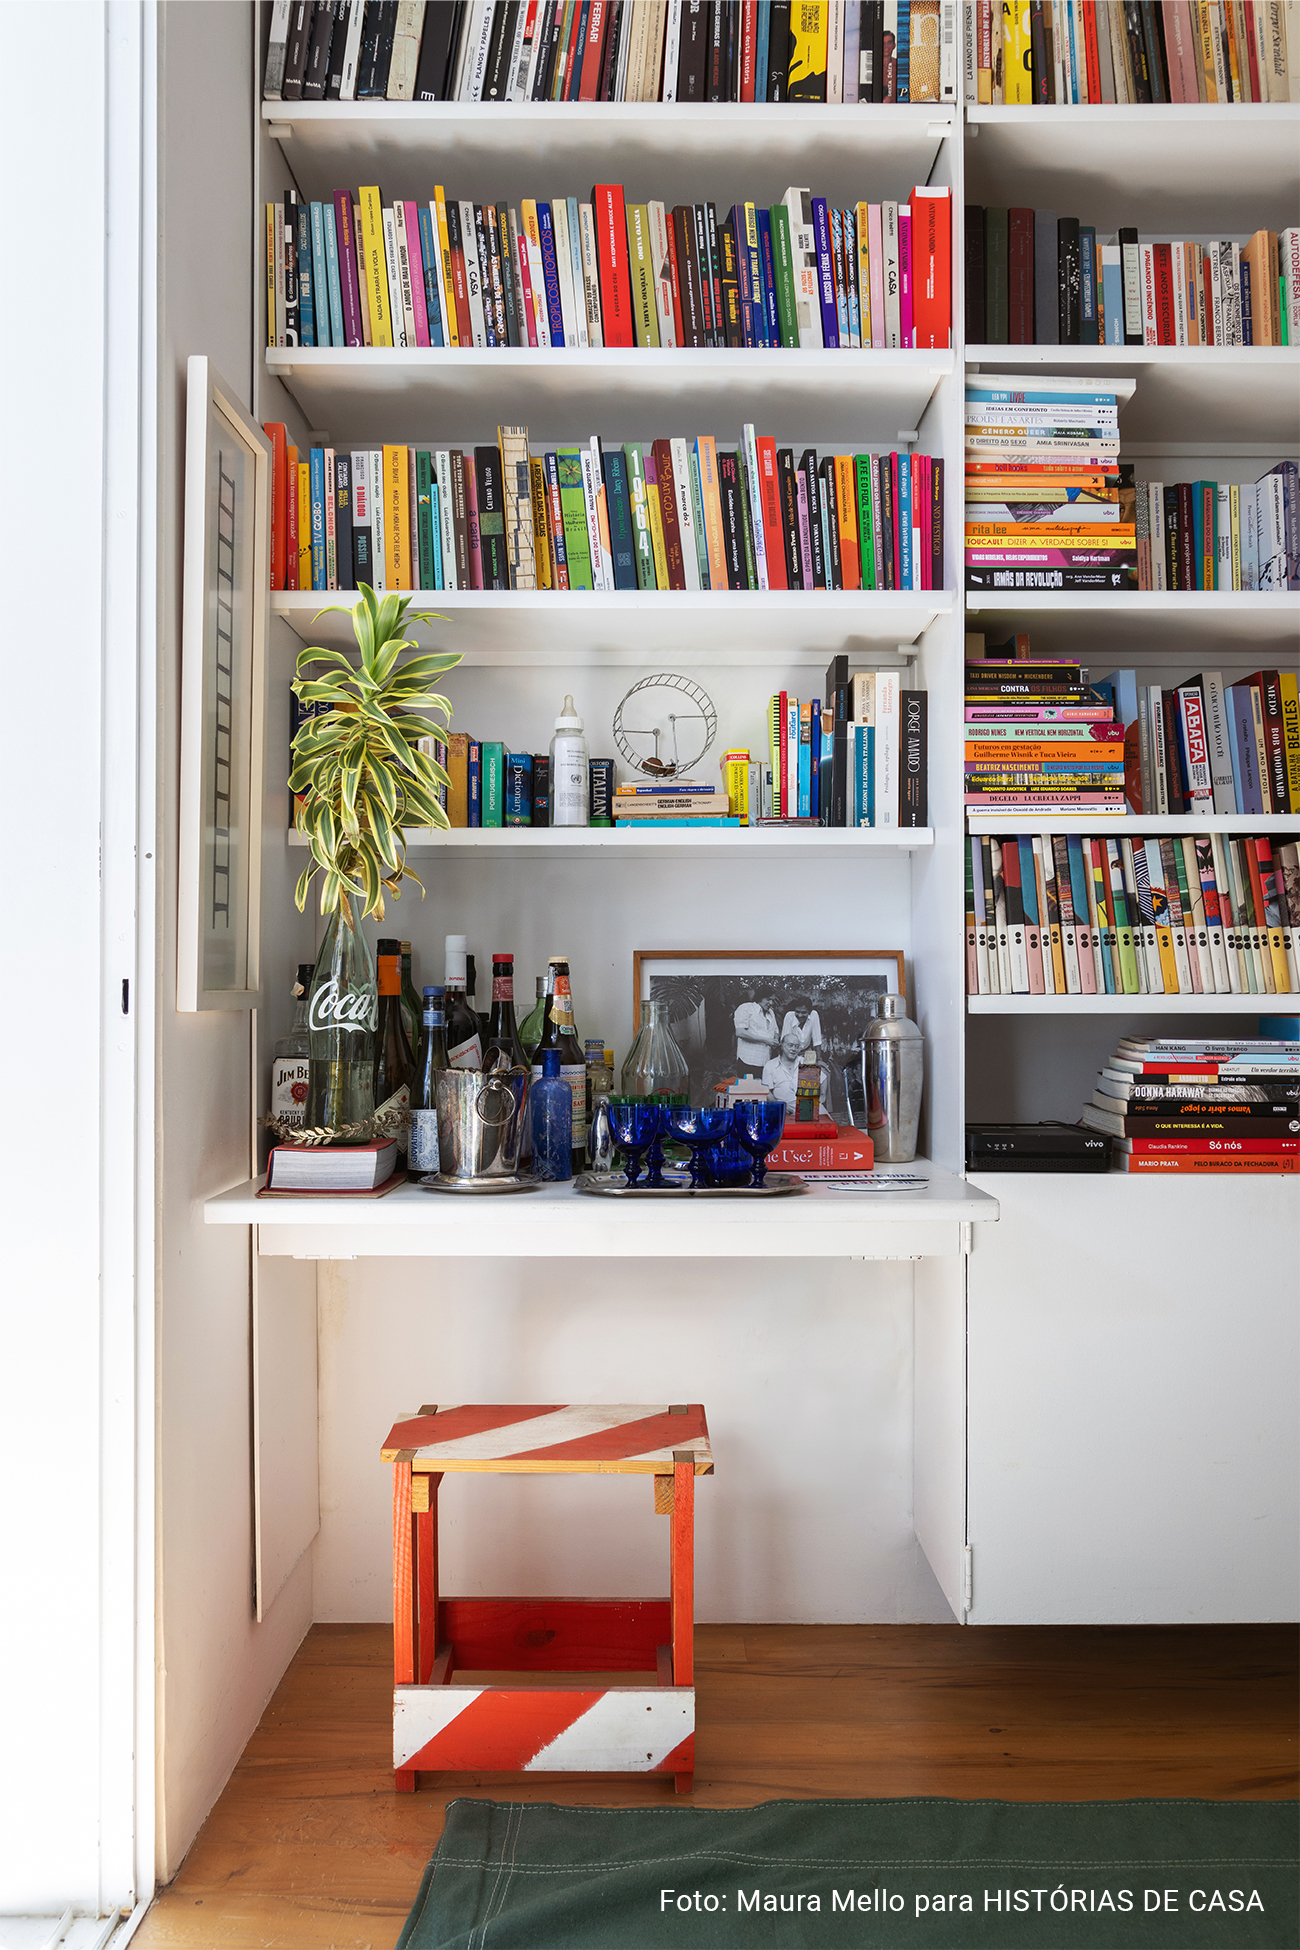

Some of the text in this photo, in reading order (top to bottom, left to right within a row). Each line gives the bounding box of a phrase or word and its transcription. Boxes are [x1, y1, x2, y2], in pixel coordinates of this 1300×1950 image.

[590, 2, 601, 43] FERRARI
[306, 81, 321, 89] MoMA
[634, 209, 642, 235] VENTO
[1159, 248, 1167, 269] SETE
[1290, 232, 1300, 300] AUTODEFESA
[374, 268, 379, 276] DE
[401, 267, 409, 280] MAU
[470, 271, 478, 296] CASA
[639, 266, 648, 300] ANTÔNIO
[888, 270, 897, 296] CASA
[1221, 266, 1232, 290] ASFIXIA
[403, 290, 411, 305] AMOR
[861, 466, 868, 475] FÉ
[535, 469, 544, 500] REPÚBLICA
[357, 492, 367, 517] DIÁLOGO
[631, 450, 649, 556] 1964
[313, 502, 322, 543] TV GLOBO
[538, 513, 546, 537] MILÍCIAS
[933, 506, 942, 555] NO VESTÍGIO
[972, 524, 1007, 534] rita lee
[1206, 527, 1210, 536] DO
[470, 522, 479, 549] carta
[357, 536, 367, 564] POSSÍVEL
[994, 571, 1062, 588] IRMÃS DA REVOLUÇÃO
[1267, 685, 1277, 715] MEDO
[908, 698, 921, 772] JORGE AMADO
[1186, 702, 1204, 762] ABAFA
[1285, 700, 1299, 749] BEATLES
[1271, 728, 1285, 798] BOB WOODWARD
[512, 765, 523, 815] Dictionary
[592, 767, 606, 817] ITALIAN
[277, 1066, 309, 1087] JIM BE
[1135, 1086, 1205, 1098] DONNA HARAWAY
[1180, 1105, 1200, 1113] jogo?
[782, 1149, 813, 1163] Use?
[1209, 1140, 1242, 1150] Só nós
